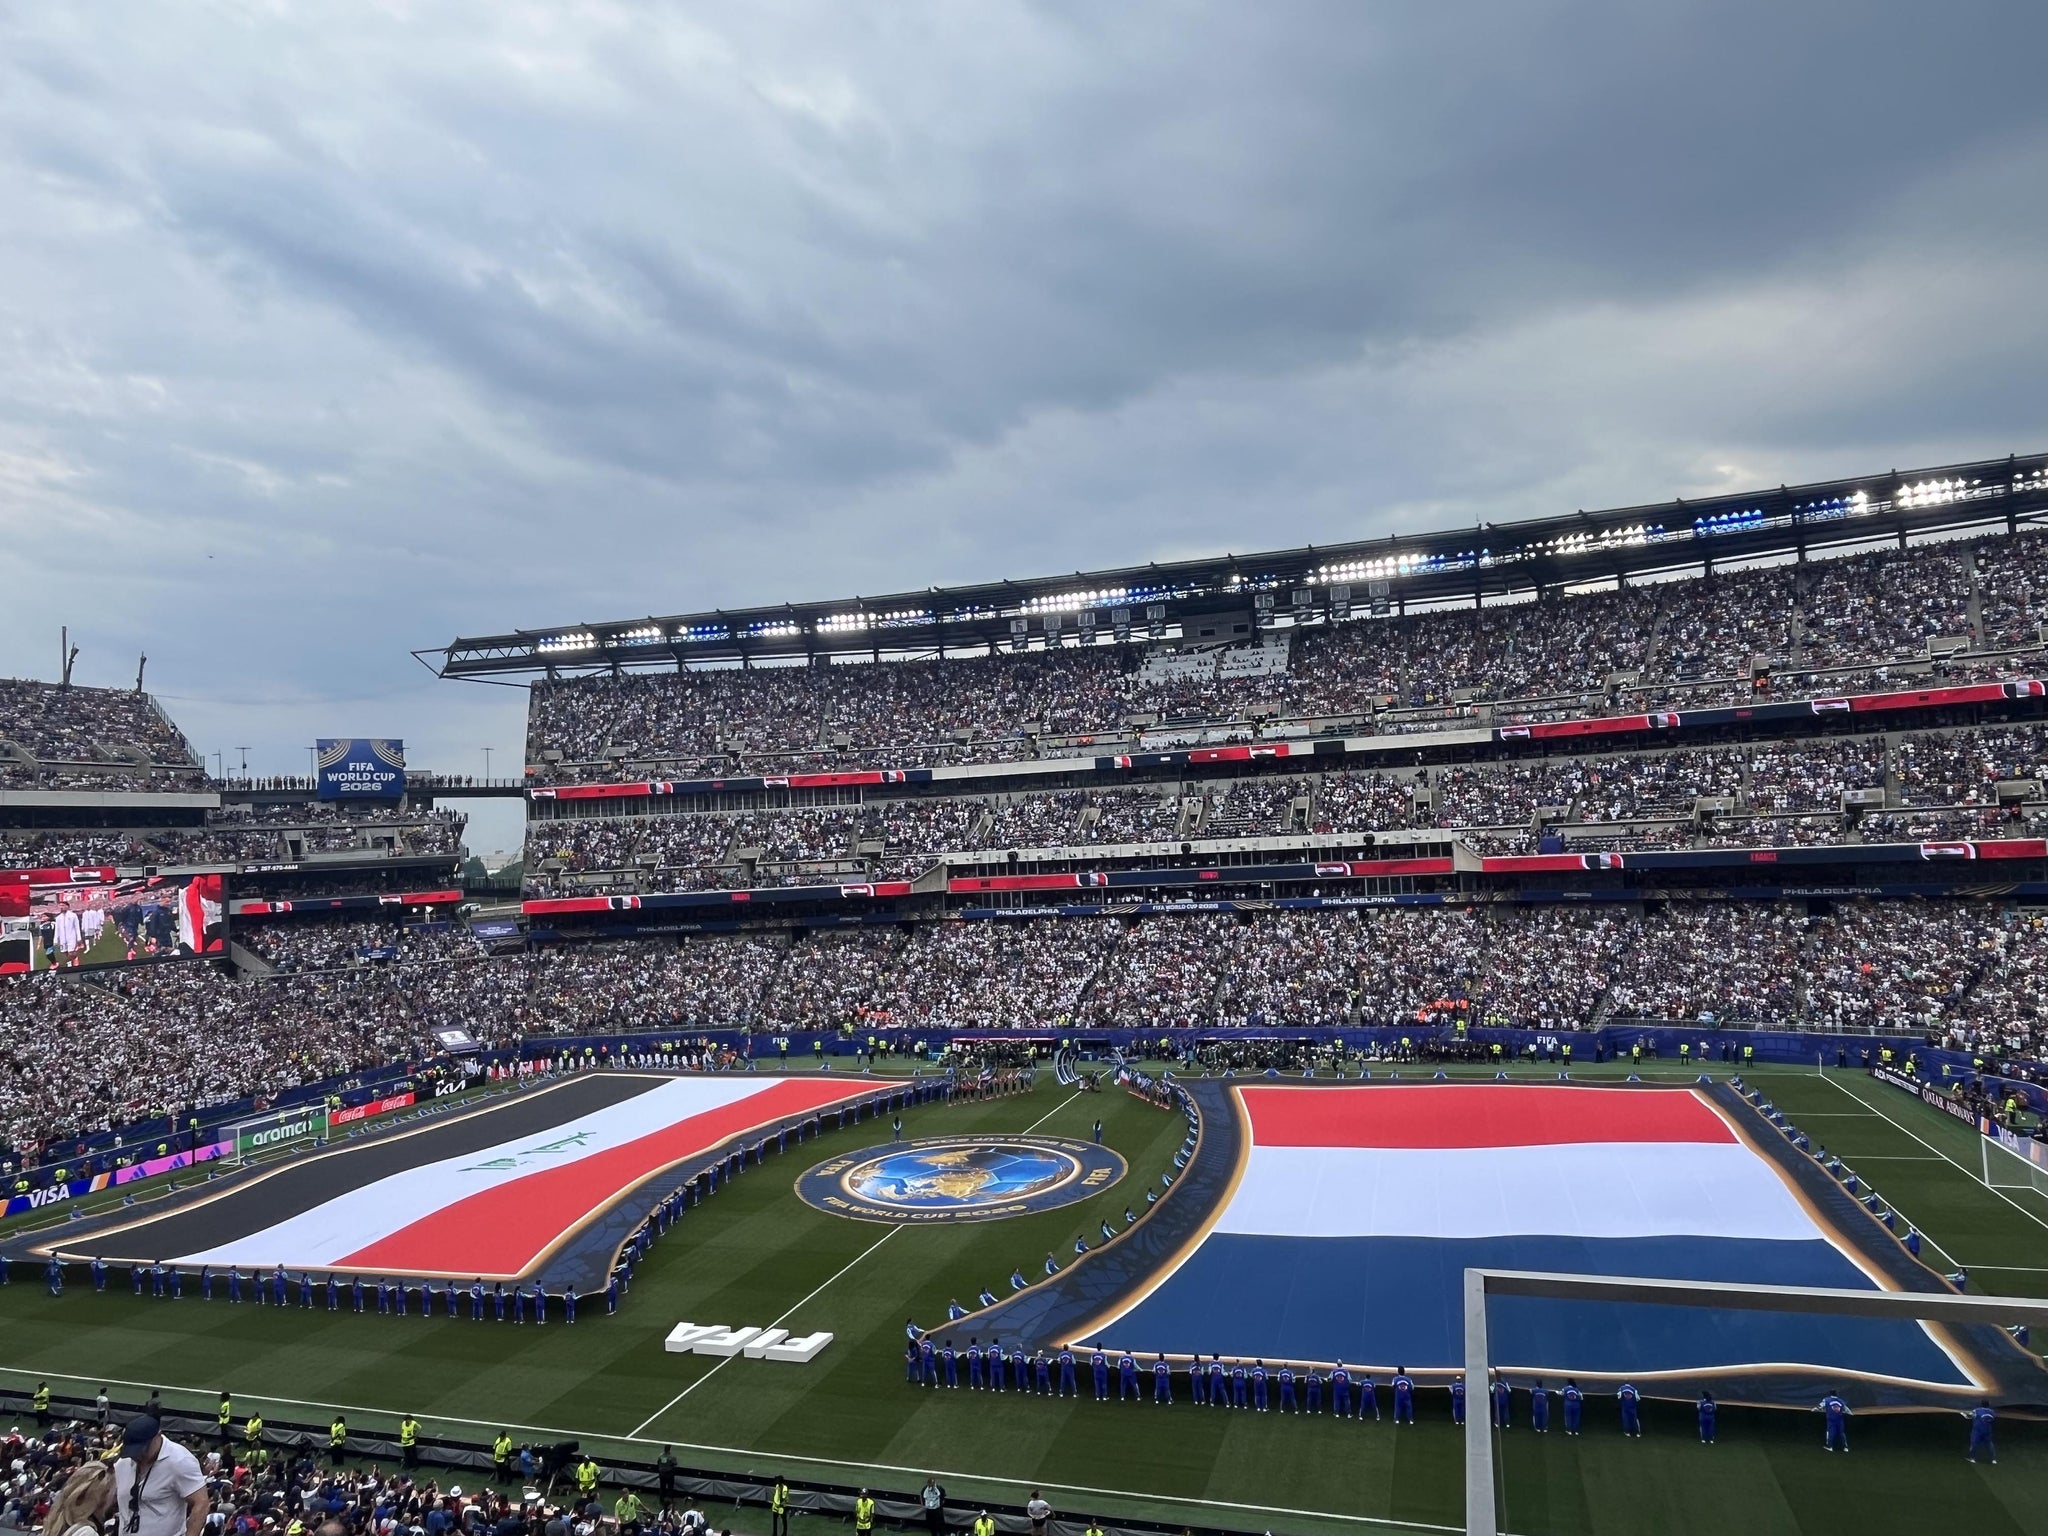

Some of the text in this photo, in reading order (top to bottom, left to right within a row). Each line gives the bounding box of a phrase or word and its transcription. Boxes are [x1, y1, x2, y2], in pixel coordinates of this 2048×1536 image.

[349, 762, 375, 772] FIFA
[327, 772, 396, 782] WORLD CUP
[340, 782, 382, 792] 2026
[1783, 887, 1882, 895] PHILADELPHIA
[1322, 896, 1396, 905] PHILADELPHIA
[996, 908, 1060, 916] PHILADELPHIA
[636, 924, 702, 932] PHILADELPHIA
[1537, 1036, 1558, 1045] FIFA
[1922, 1088, 1976, 1126] QATAR AIRWAYS
[252, 1120, 313, 1146] aramco
[1995, 1124, 2020, 1151] VISA
[815, 1159, 855, 1176] FIFA
[1080, 1167, 1113, 1186] FIFA
[25, 1183, 70, 1208] VISA
[822, 1196, 850, 1209] FIFA
[849, 1205, 908, 1218] WORLD
[665, 1322, 834, 1363] FIFA
